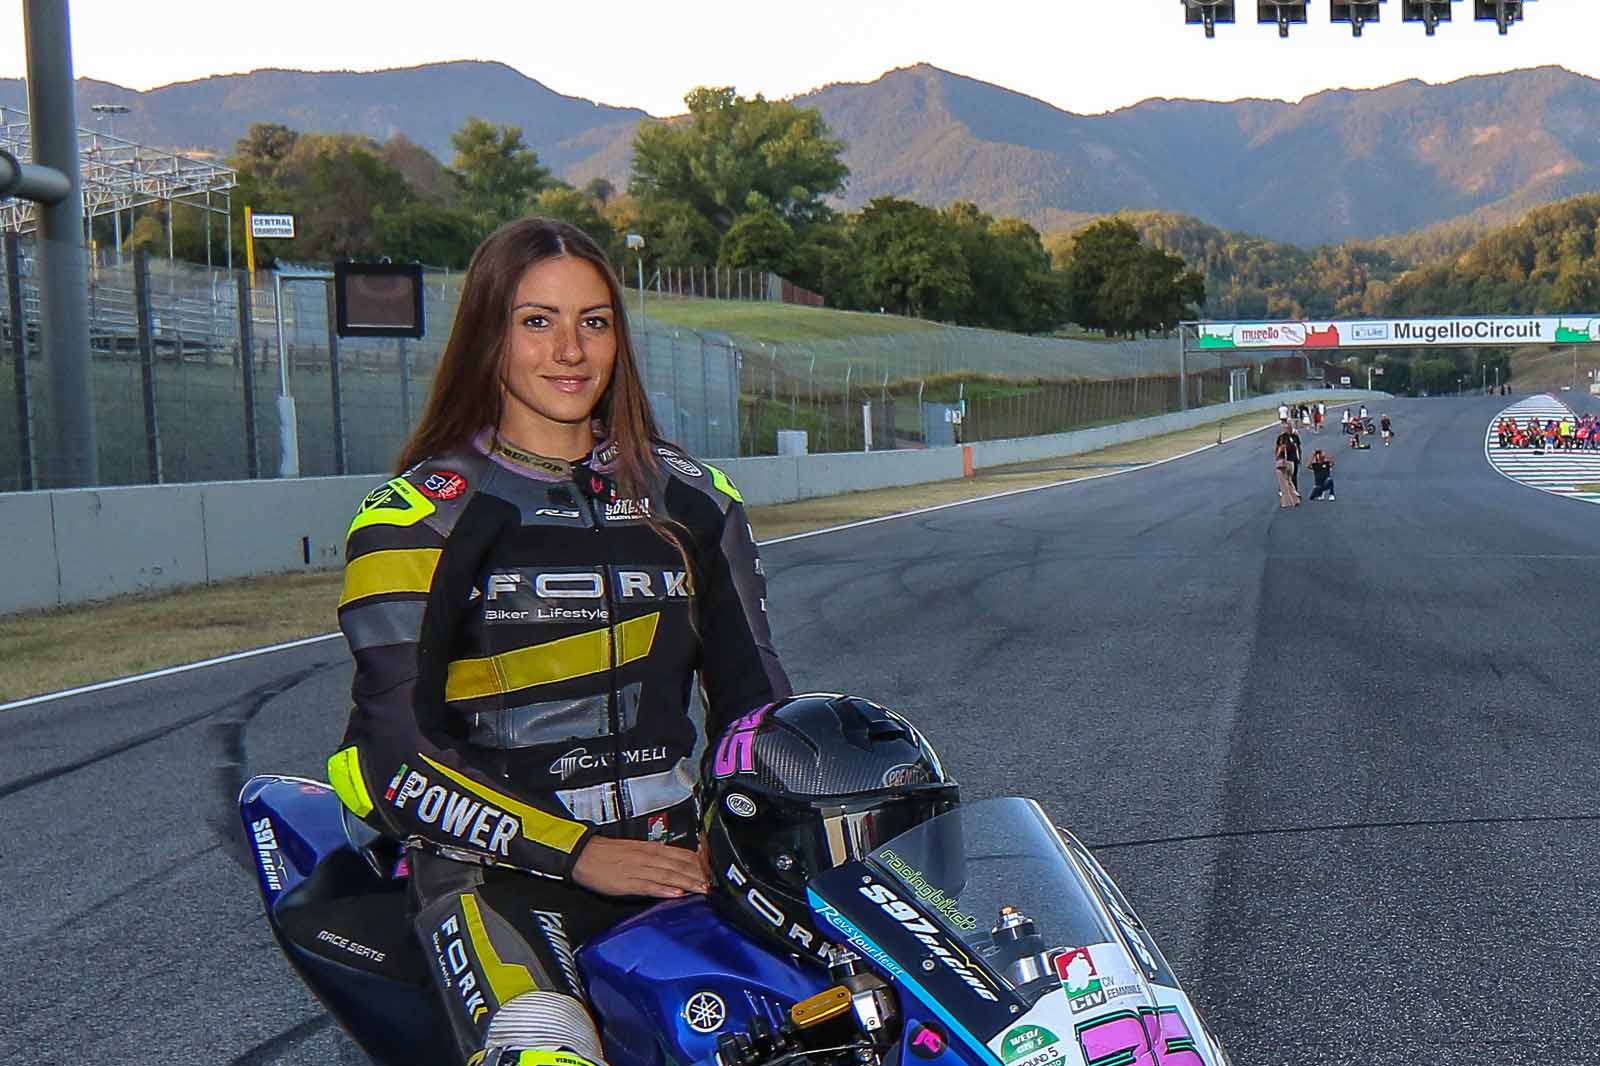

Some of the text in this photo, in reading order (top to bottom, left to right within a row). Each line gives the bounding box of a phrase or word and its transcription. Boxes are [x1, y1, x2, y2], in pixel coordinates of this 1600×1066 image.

[485, 607, 609, 621] Biker Lifestyle
[403, 770, 520, 856] POWER
[317, 931, 386, 962] RACE SEATS
[441, 914, 485, 1017] FORK
[1047, 1046, 1059, 1058] 5
